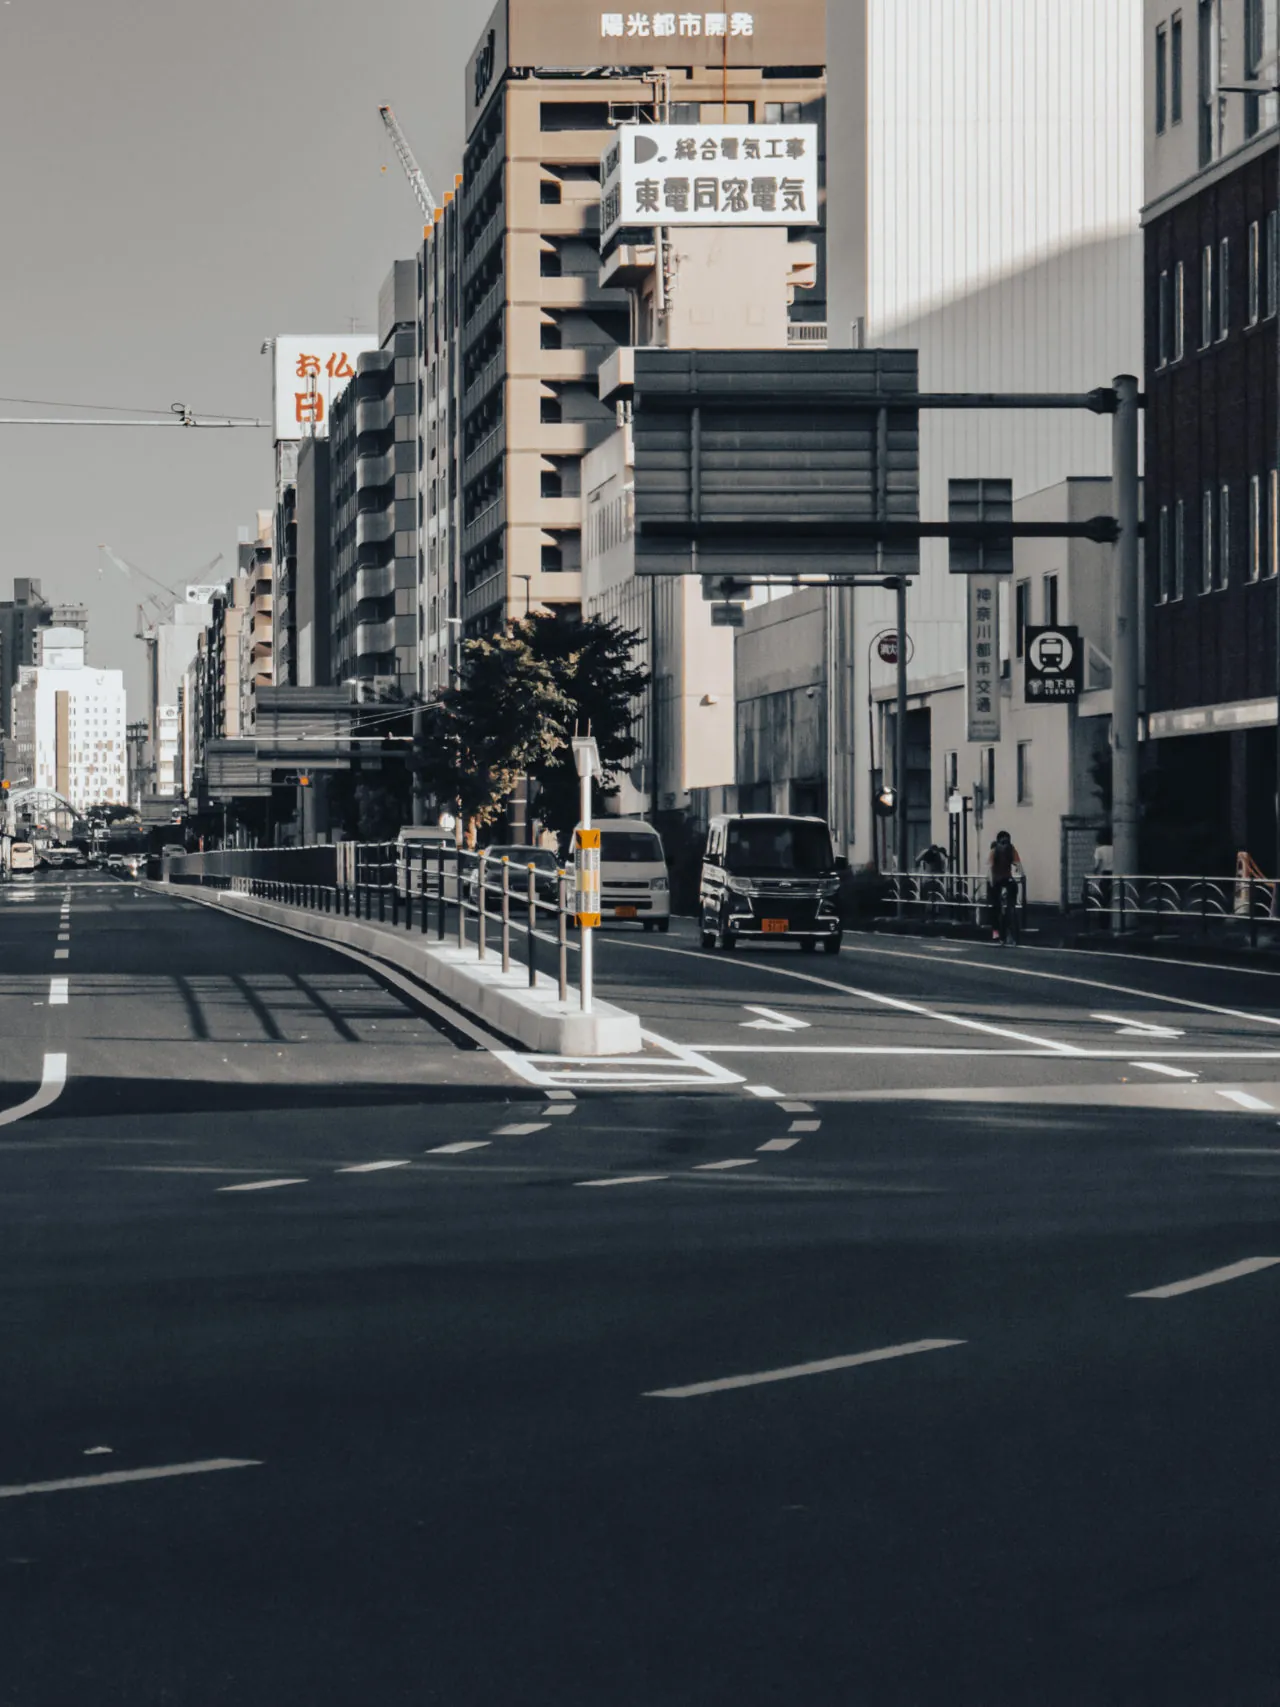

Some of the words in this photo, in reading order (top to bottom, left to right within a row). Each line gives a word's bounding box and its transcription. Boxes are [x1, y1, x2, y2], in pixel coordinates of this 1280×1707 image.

[601, 12, 754, 37] 陽光都市開発
[976, 588, 992, 713] 神奈川都市交通
[1044, 679, 1075, 689] 地下鉄
